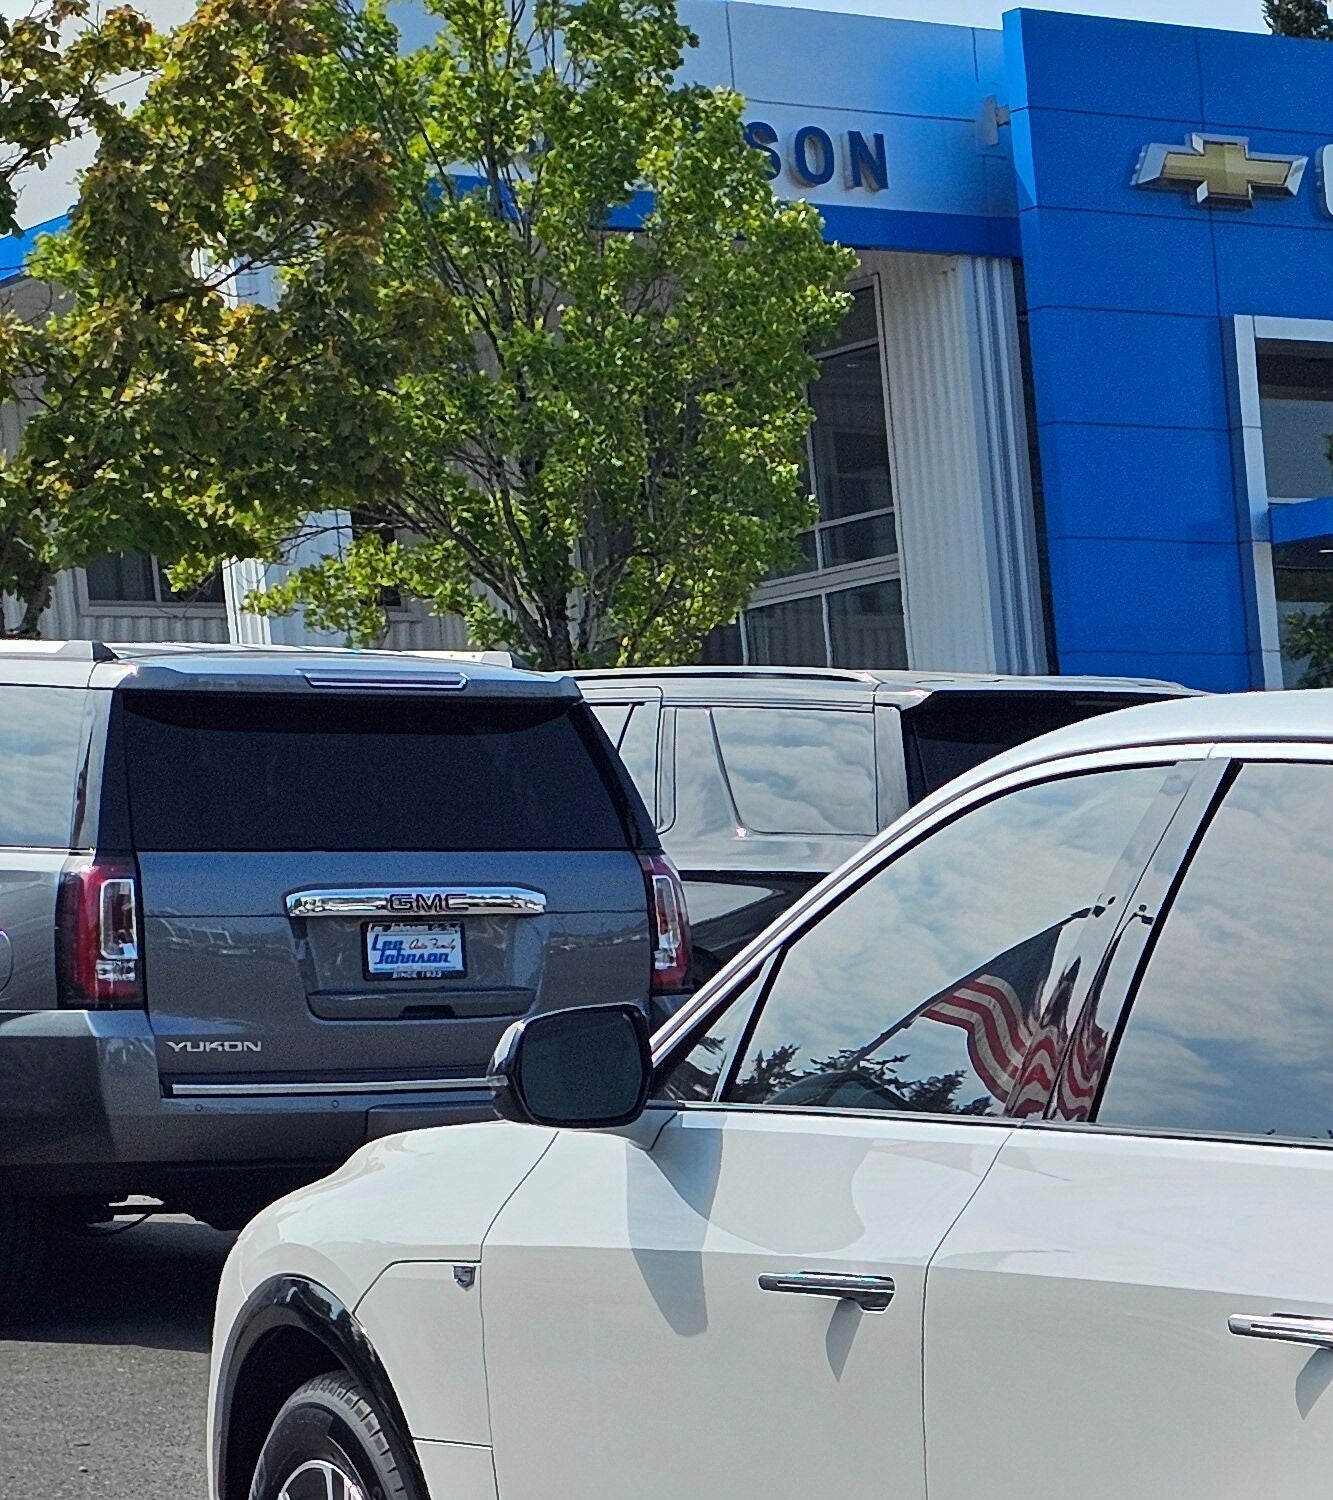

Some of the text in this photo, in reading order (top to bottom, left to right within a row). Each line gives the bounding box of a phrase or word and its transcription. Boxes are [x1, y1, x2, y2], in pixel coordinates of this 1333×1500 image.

[388, 893, 469, 912] GMC
[374, 950, 451, 965] Johnson
[165, 1041, 262, 1053] YUKON
